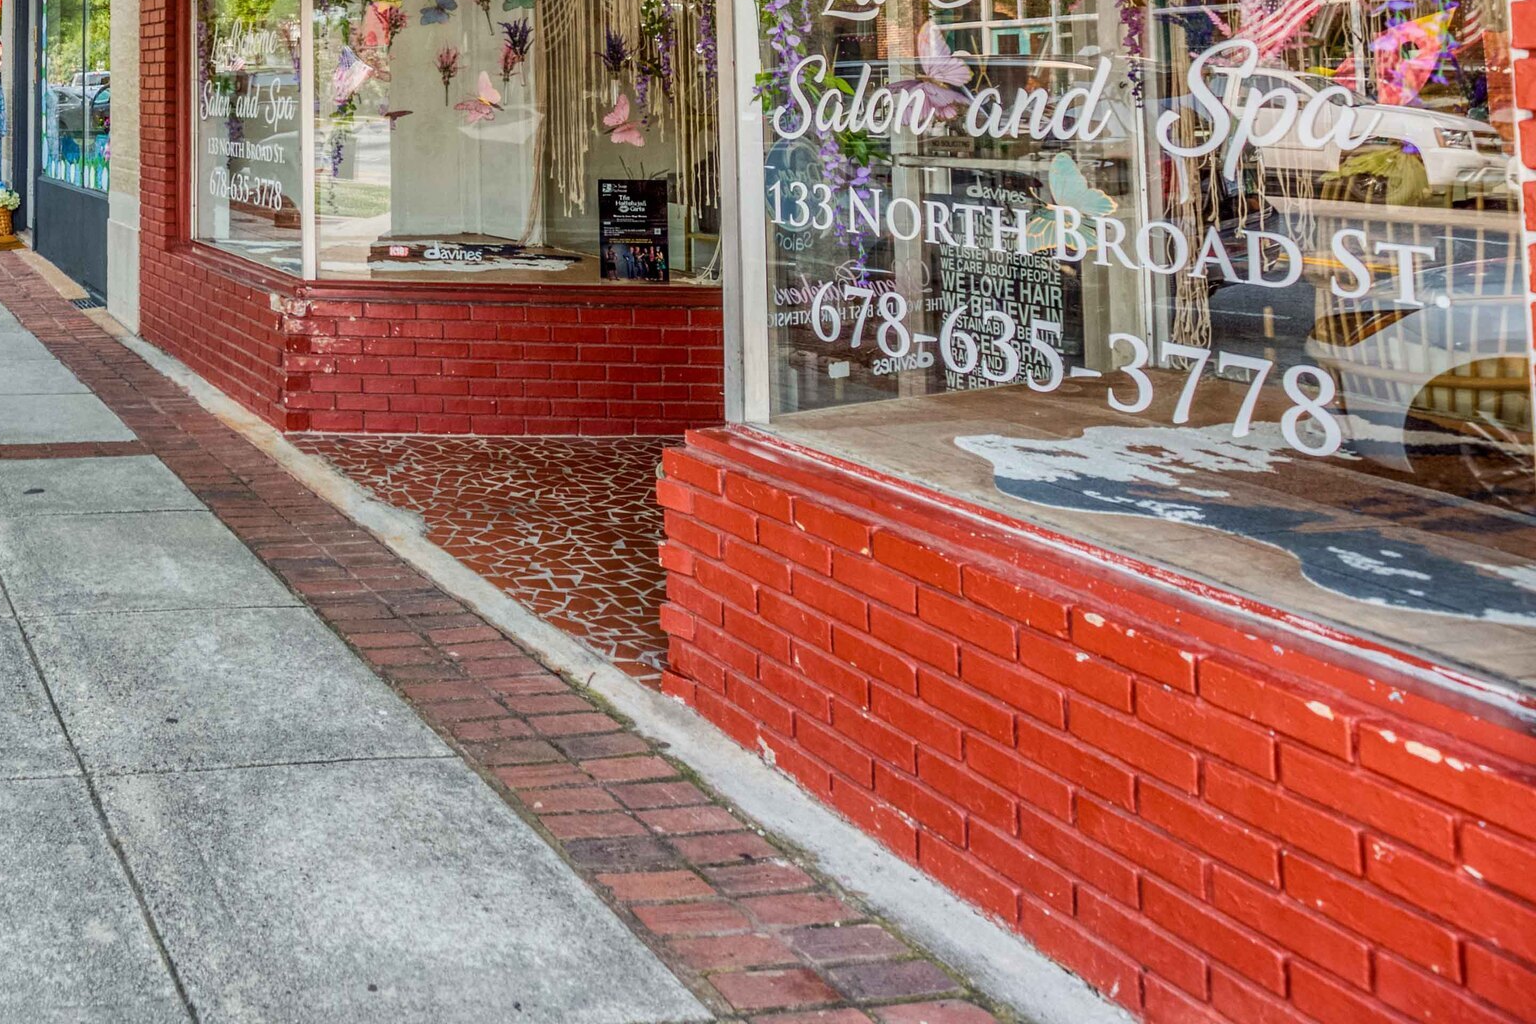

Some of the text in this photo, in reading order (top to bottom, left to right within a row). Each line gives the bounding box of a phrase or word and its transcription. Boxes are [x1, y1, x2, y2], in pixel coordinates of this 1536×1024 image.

[200, 78, 296, 132] Salon and Spa
[773, 38, 1385, 182] Salon and Spa
[207, 138, 285, 164] 133 NORTH BROAD ST.
[209, 169, 282, 212] 678-635-3778
[965, 174, 1027, 204] davines
[424, 240, 483, 261] davines
[767, 180, 1452, 309] 133 NORTH BROAD ST.
[940, 244, 1062, 272] WE LISTEN TO REQUESTS
[940, 257, 1062, 286] WE CARE ABOUT PEOPLE
[941, 270, 1063, 308] WE LOVE HAIR
[942, 291, 1064, 329] WE BELIEVE IN
[809, 280, 1342, 457] 678-635-3778
[945, 369, 964, 390] WE
